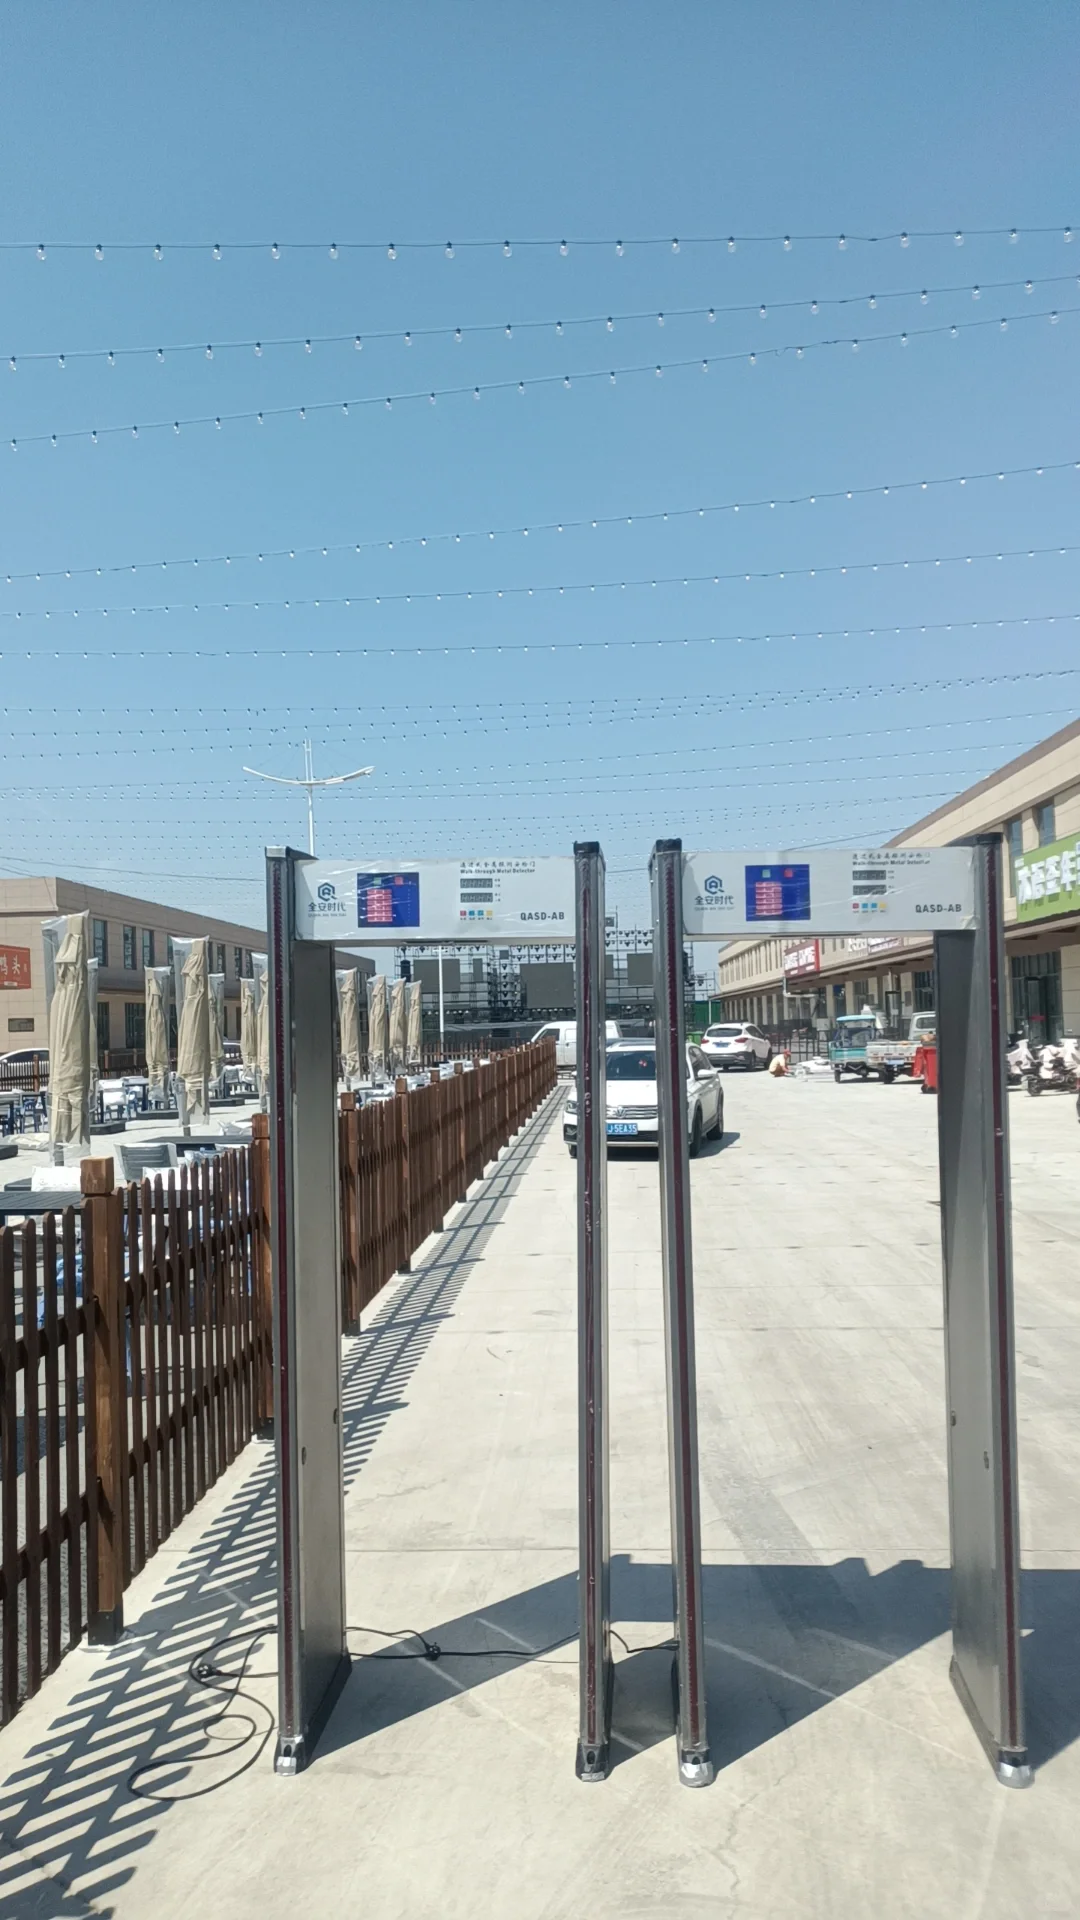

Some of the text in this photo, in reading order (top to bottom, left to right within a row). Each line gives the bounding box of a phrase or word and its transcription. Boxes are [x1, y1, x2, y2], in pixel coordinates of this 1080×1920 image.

[694, 895, 734, 905] 全安时代
[308, 902, 347, 912] 全安时代
[915, 904, 962, 913] QASD-AB
[520, 911, 565, 921] QASD-AB
